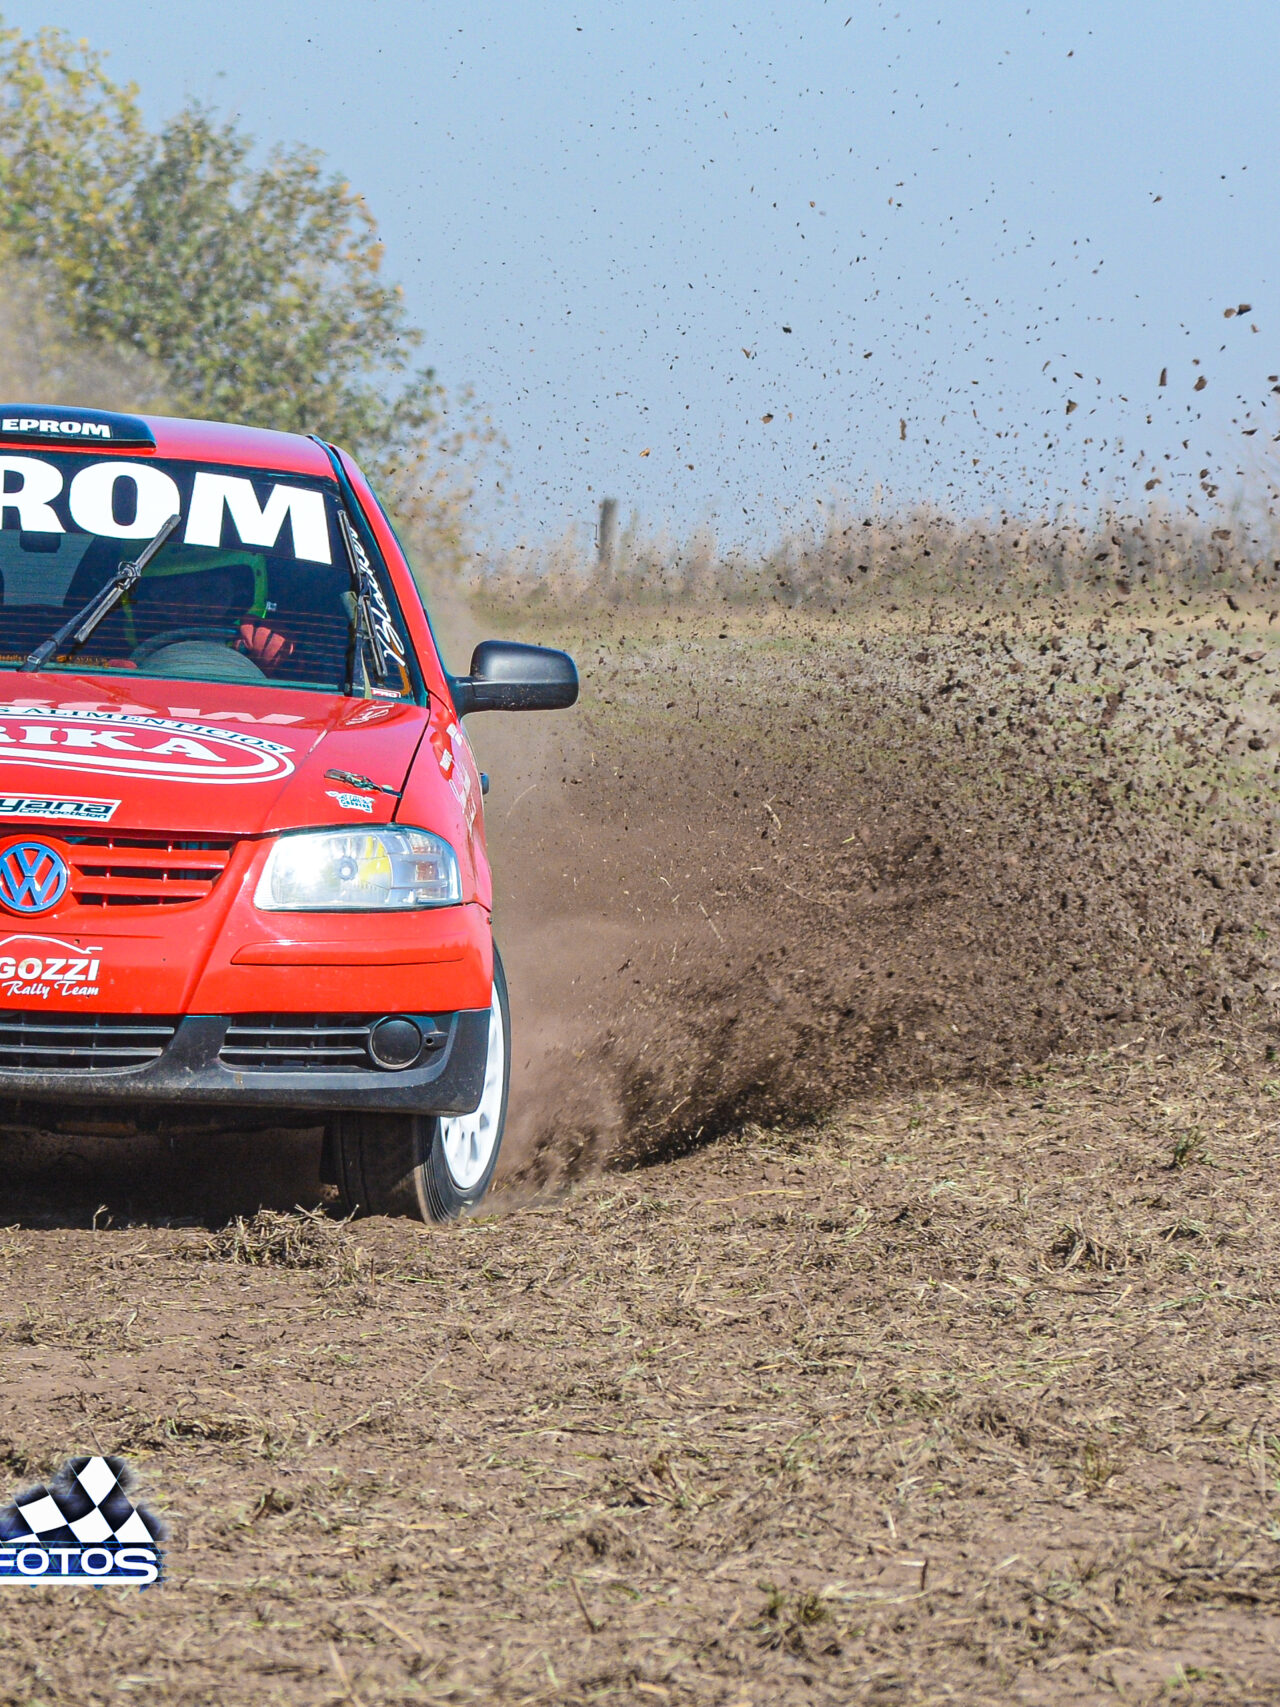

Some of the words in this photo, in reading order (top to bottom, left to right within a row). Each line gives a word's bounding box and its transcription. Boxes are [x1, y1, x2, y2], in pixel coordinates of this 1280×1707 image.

[1, 419, 111, 438] EPROM
[24, 707, 285, 751] ALIMENTICIOS
[2, 981, 50, 999] Rally
[54, 981, 99, 996] Team
